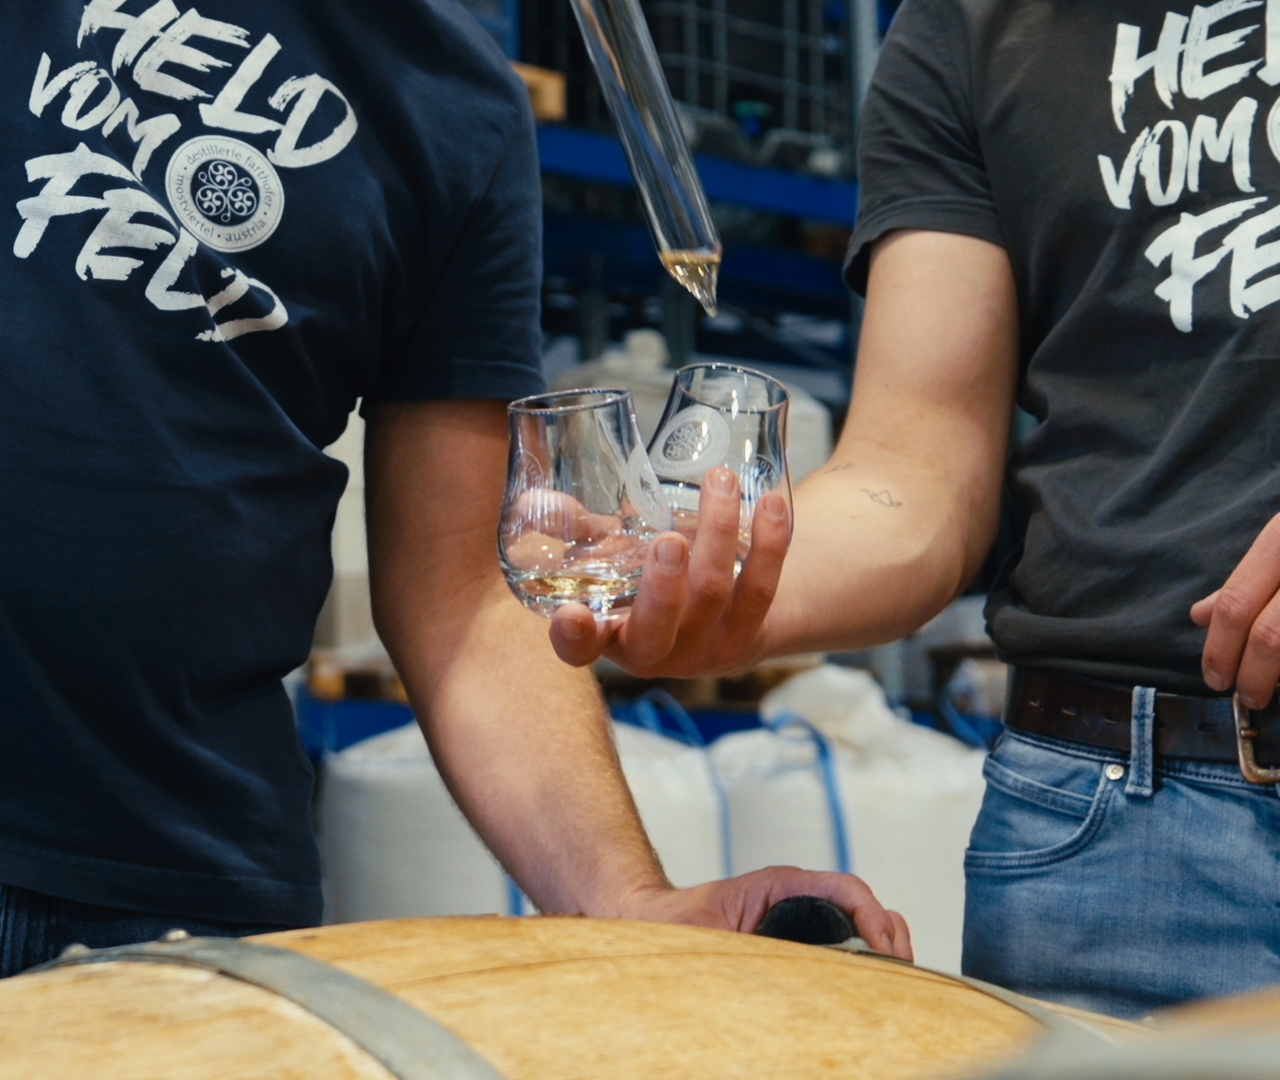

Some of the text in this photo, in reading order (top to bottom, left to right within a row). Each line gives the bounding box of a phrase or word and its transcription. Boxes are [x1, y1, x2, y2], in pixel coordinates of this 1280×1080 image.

[28, 51, 181, 180] VOM
[1097, 97, 1257, 210] VOM
[175, 173, 267, 242] mostviertel austria
[186, 144, 276, 208] destillerie farthofer
[13, 142, 289, 342] FELD
